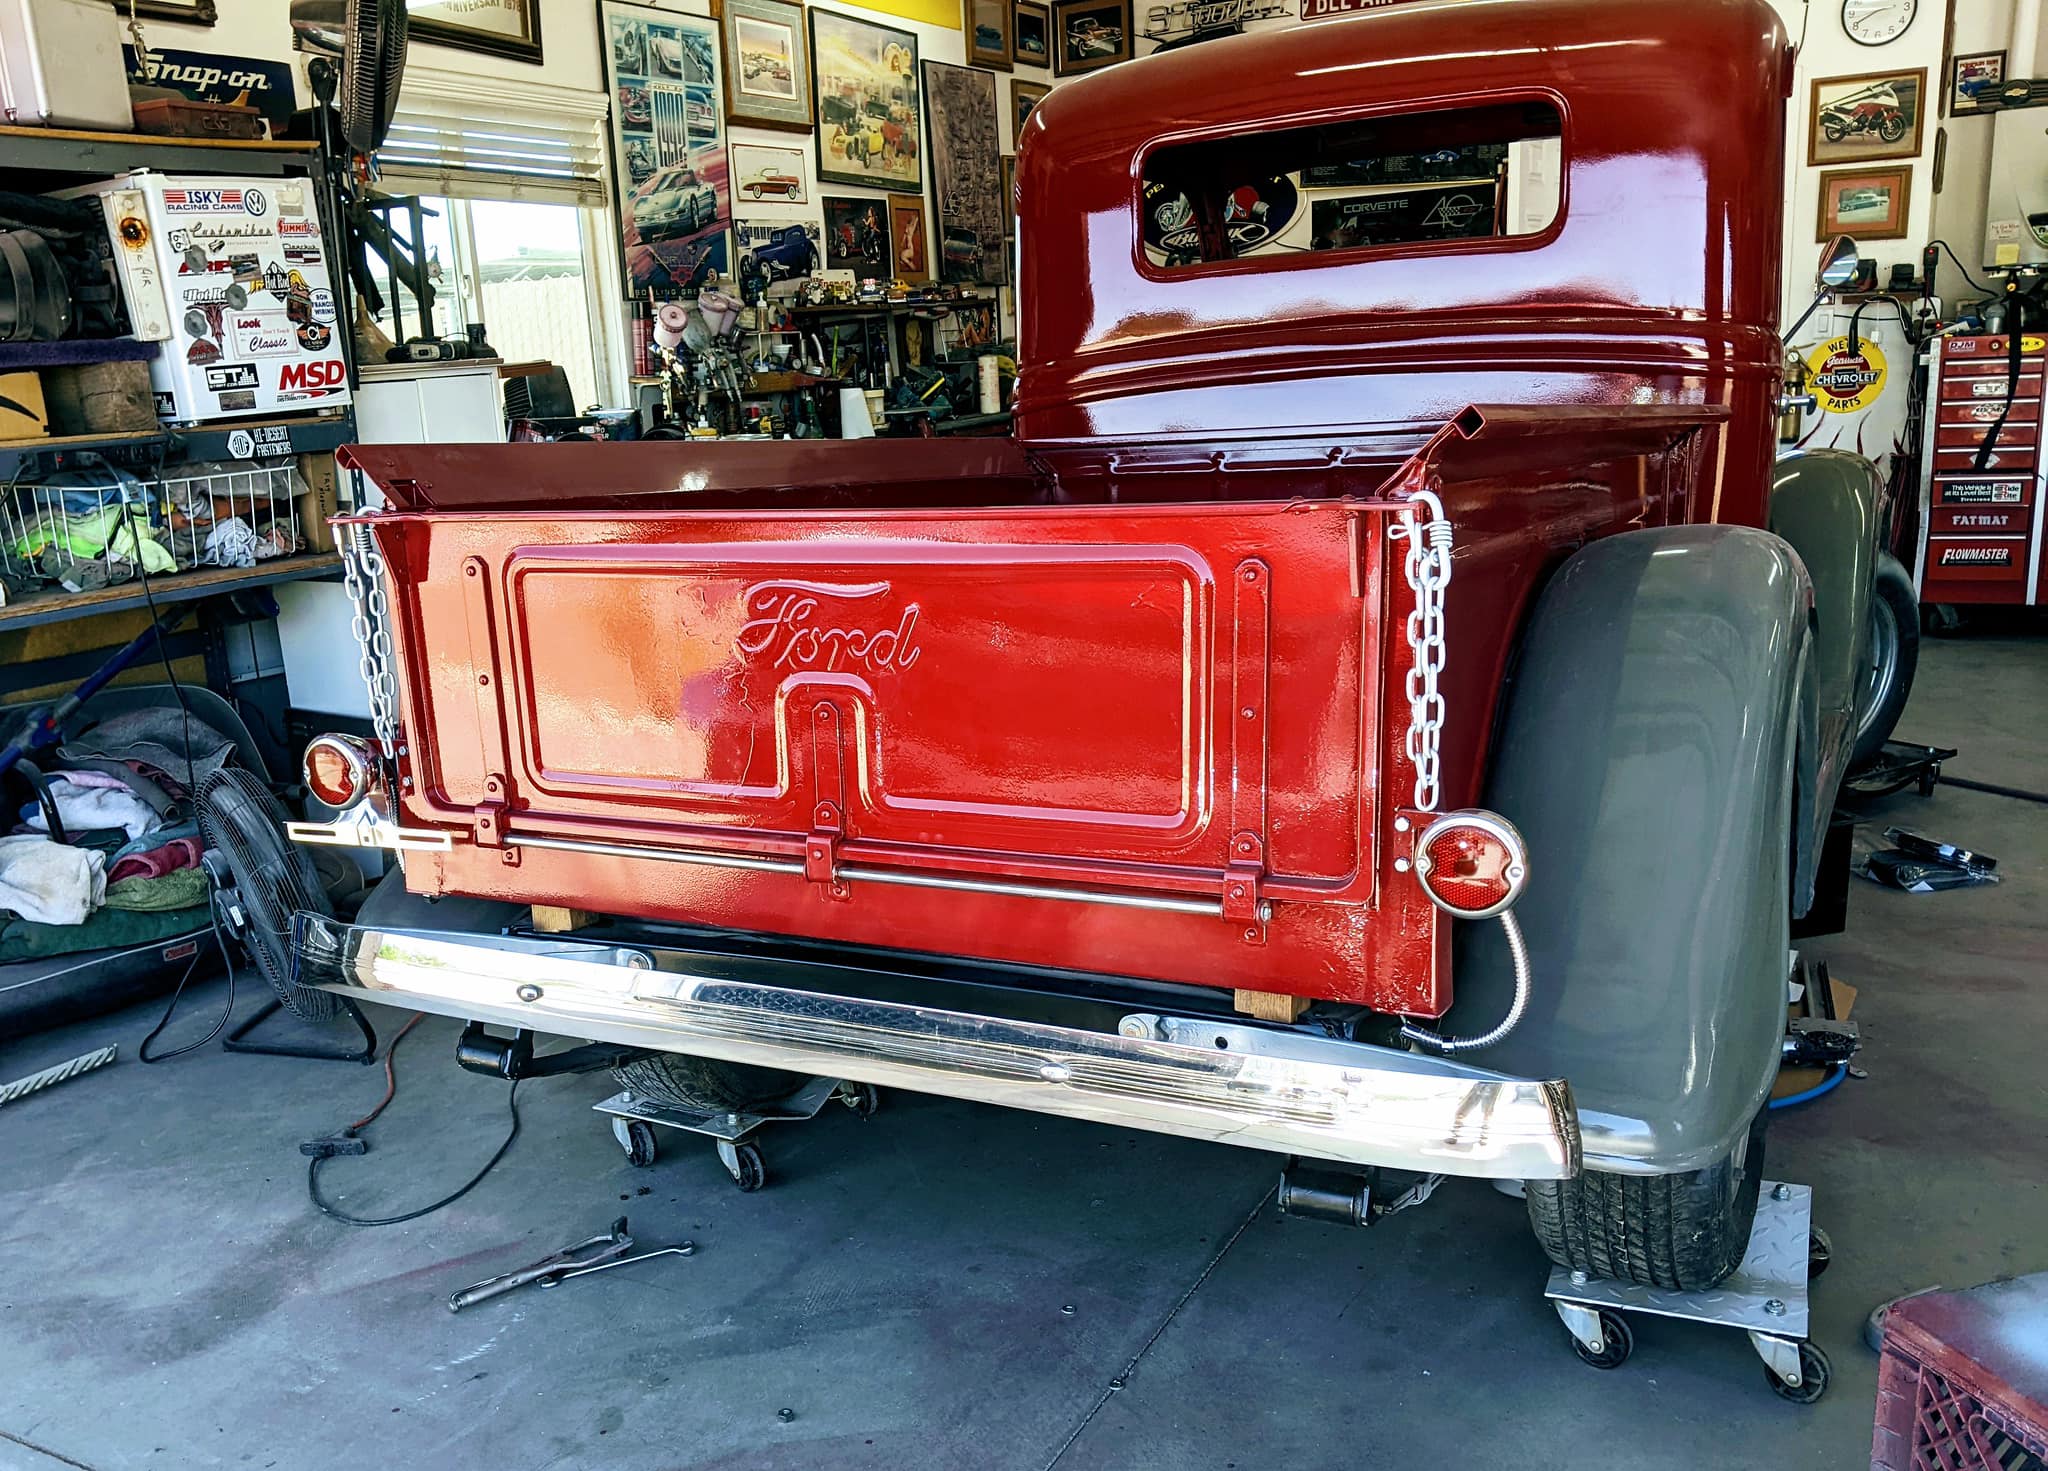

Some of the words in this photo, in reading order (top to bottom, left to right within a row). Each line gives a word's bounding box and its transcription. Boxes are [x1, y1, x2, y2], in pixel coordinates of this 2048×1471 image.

[1904, 1, 1911, 11] 3
[1898, 16, 1905, 24] 4
[1852, 22, 1859, 31] 8
[1888, 26, 1895, 35] 5
[1862, 29, 1869, 38] 7
[134, 53, 268, 92] Snap-on
[187, 191, 222, 203] ISKY
[167, 203, 210, 211] RACING
[212, 202, 245, 211] CAMS
[1343, 199, 1409, 214] CORVETTE
[315, 293, 328, 301] RON
[634, 288, 677, 296] BOLING
[237, 318, 261, 329] Look
[250, 335, 288, 353] Classic
[279, 360, 345, 391] MSD
[1816, 373, 1876, 385] CHEVROLET
[1827, 396, 1861, 409] PARTS
[1941, 548, 2009, 565] FLOWMASTER
[735, 578, 921, 674] Ford
